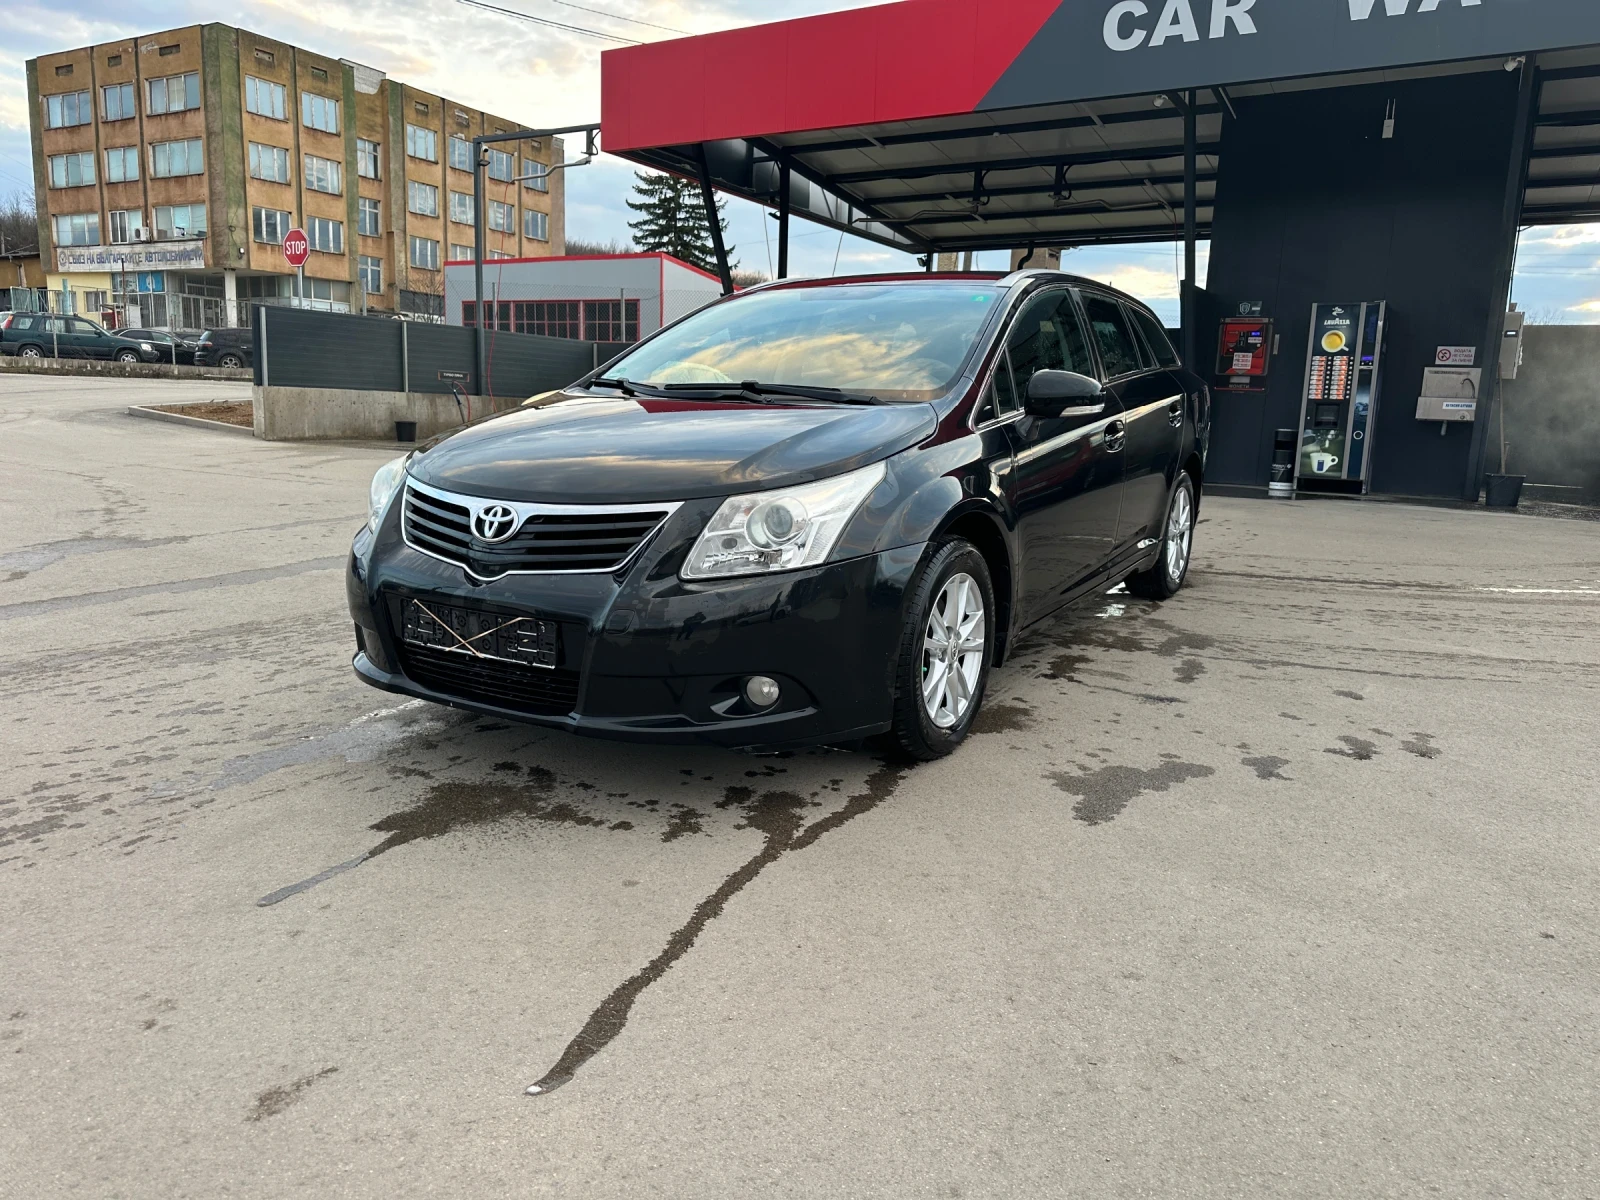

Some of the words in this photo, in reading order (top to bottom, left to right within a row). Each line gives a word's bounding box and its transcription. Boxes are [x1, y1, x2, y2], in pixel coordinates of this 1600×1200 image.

[1103, 0, 1257, 51] CAR
[286, 241, 306, 255] STOP
[87, 252, 95, 265] НА
[1324, 317, 1350, 326] LAVAZZA
